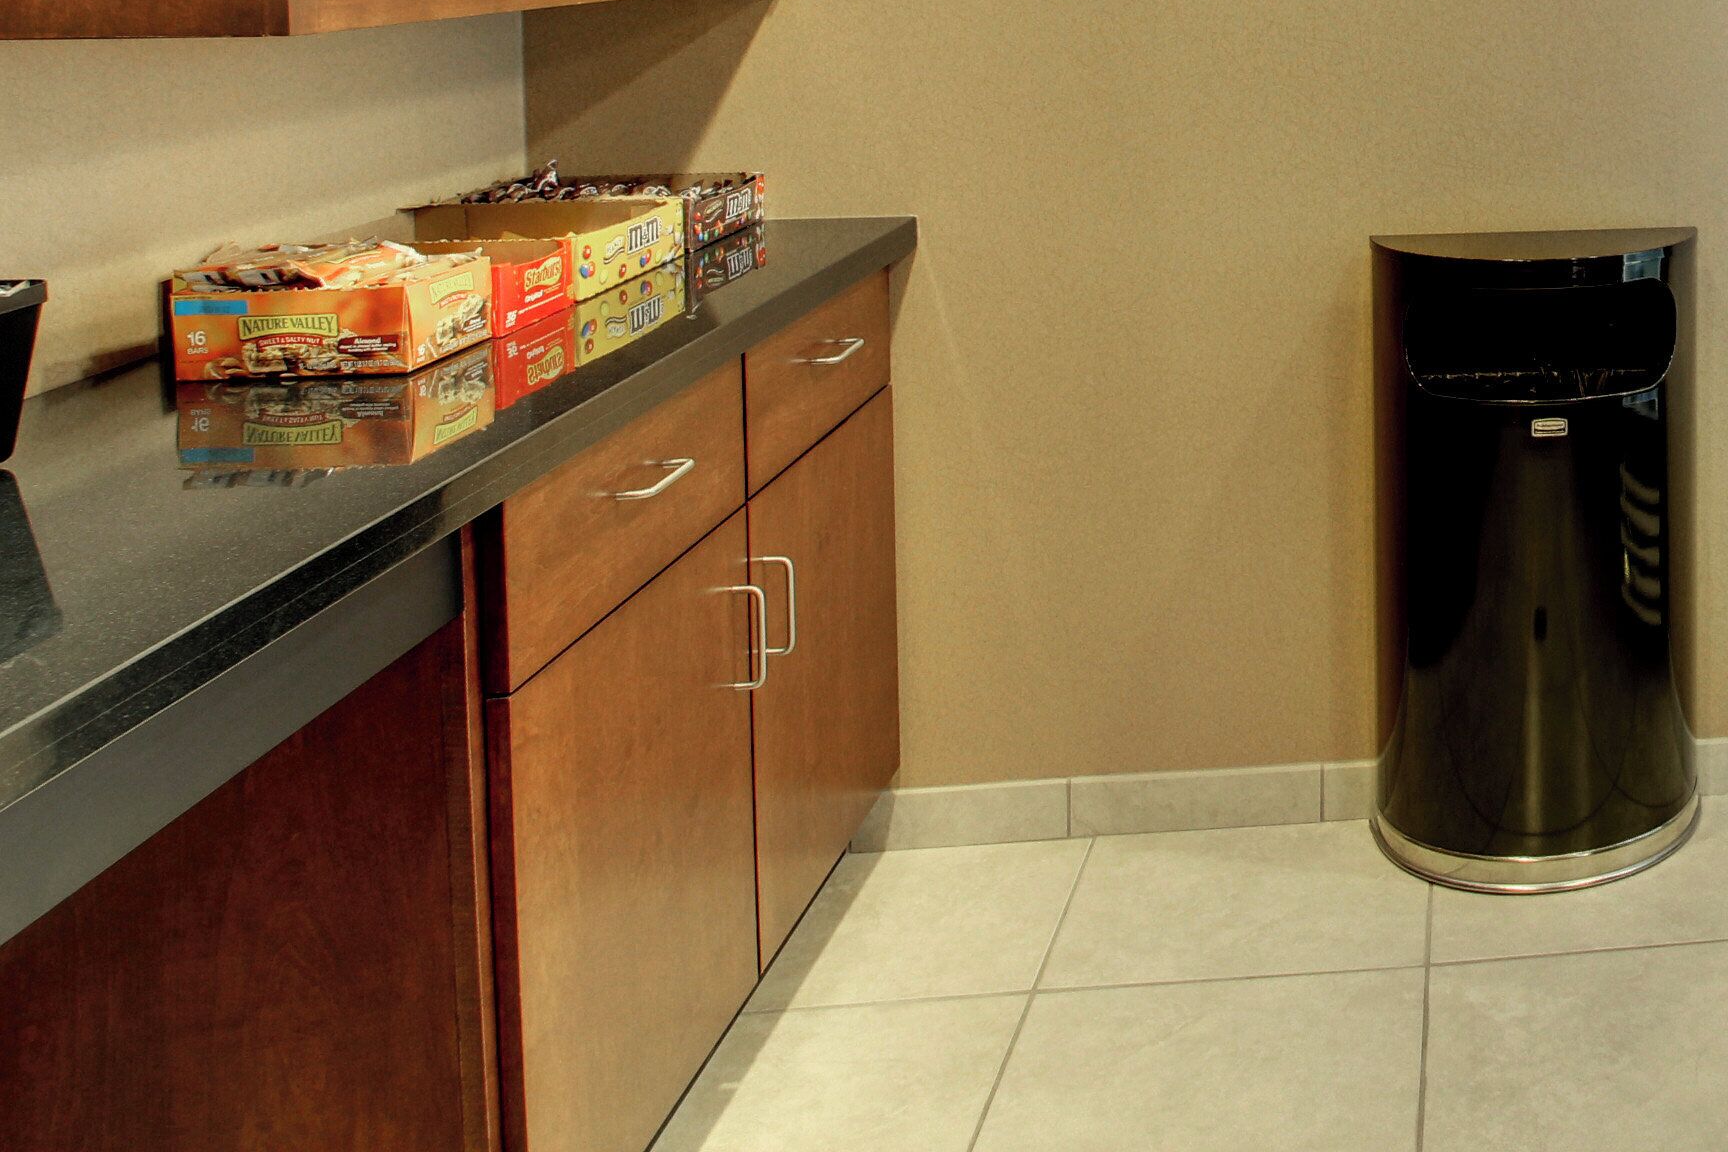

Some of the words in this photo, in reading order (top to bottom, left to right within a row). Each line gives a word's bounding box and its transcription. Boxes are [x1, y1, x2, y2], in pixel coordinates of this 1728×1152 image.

[242, 317, 288, 336] NATURE
[289, 315, 336, 334] VALLEY
[187, 330, 206, 347] 16
